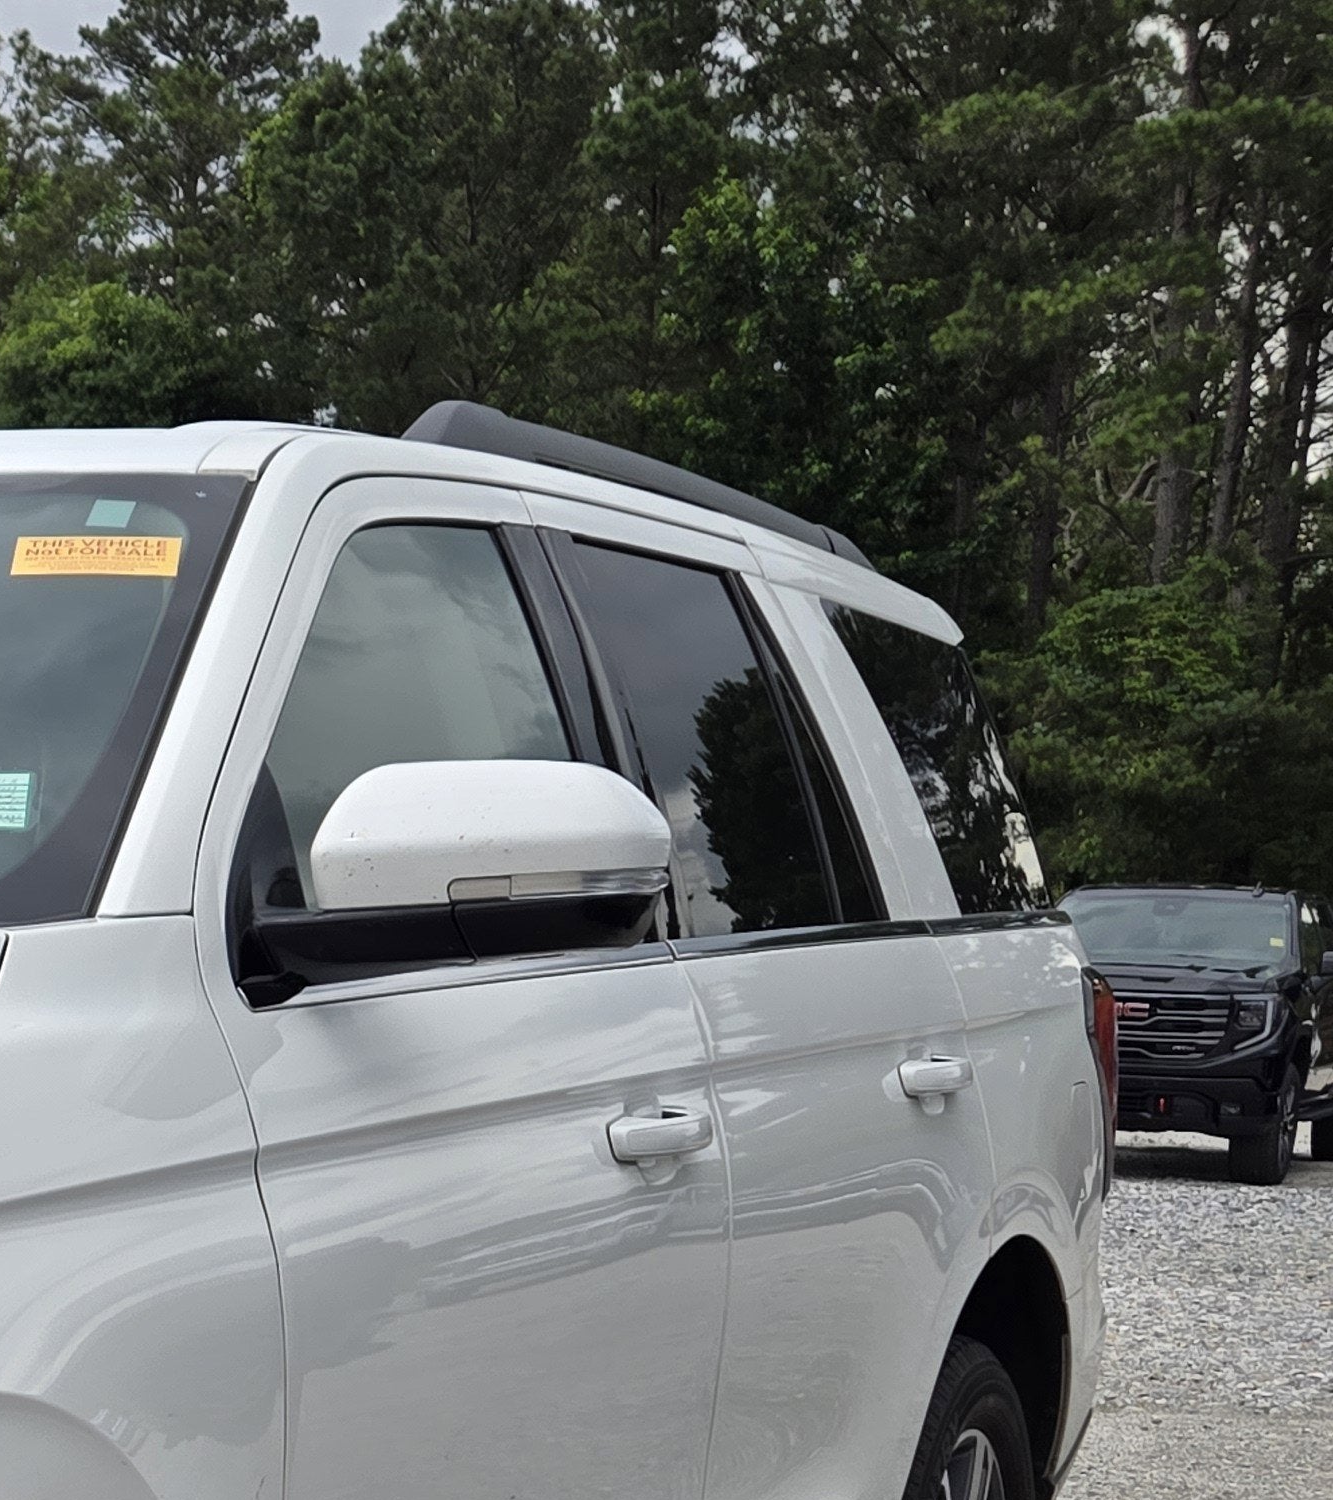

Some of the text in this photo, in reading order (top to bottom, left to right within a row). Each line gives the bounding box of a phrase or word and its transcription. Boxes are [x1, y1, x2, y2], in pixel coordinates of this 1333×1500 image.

[28, 539, 167, 549] THIS VEHICLE
[67, 547, 108, 556] FOR
[114, 548, 167, 557] SALE
